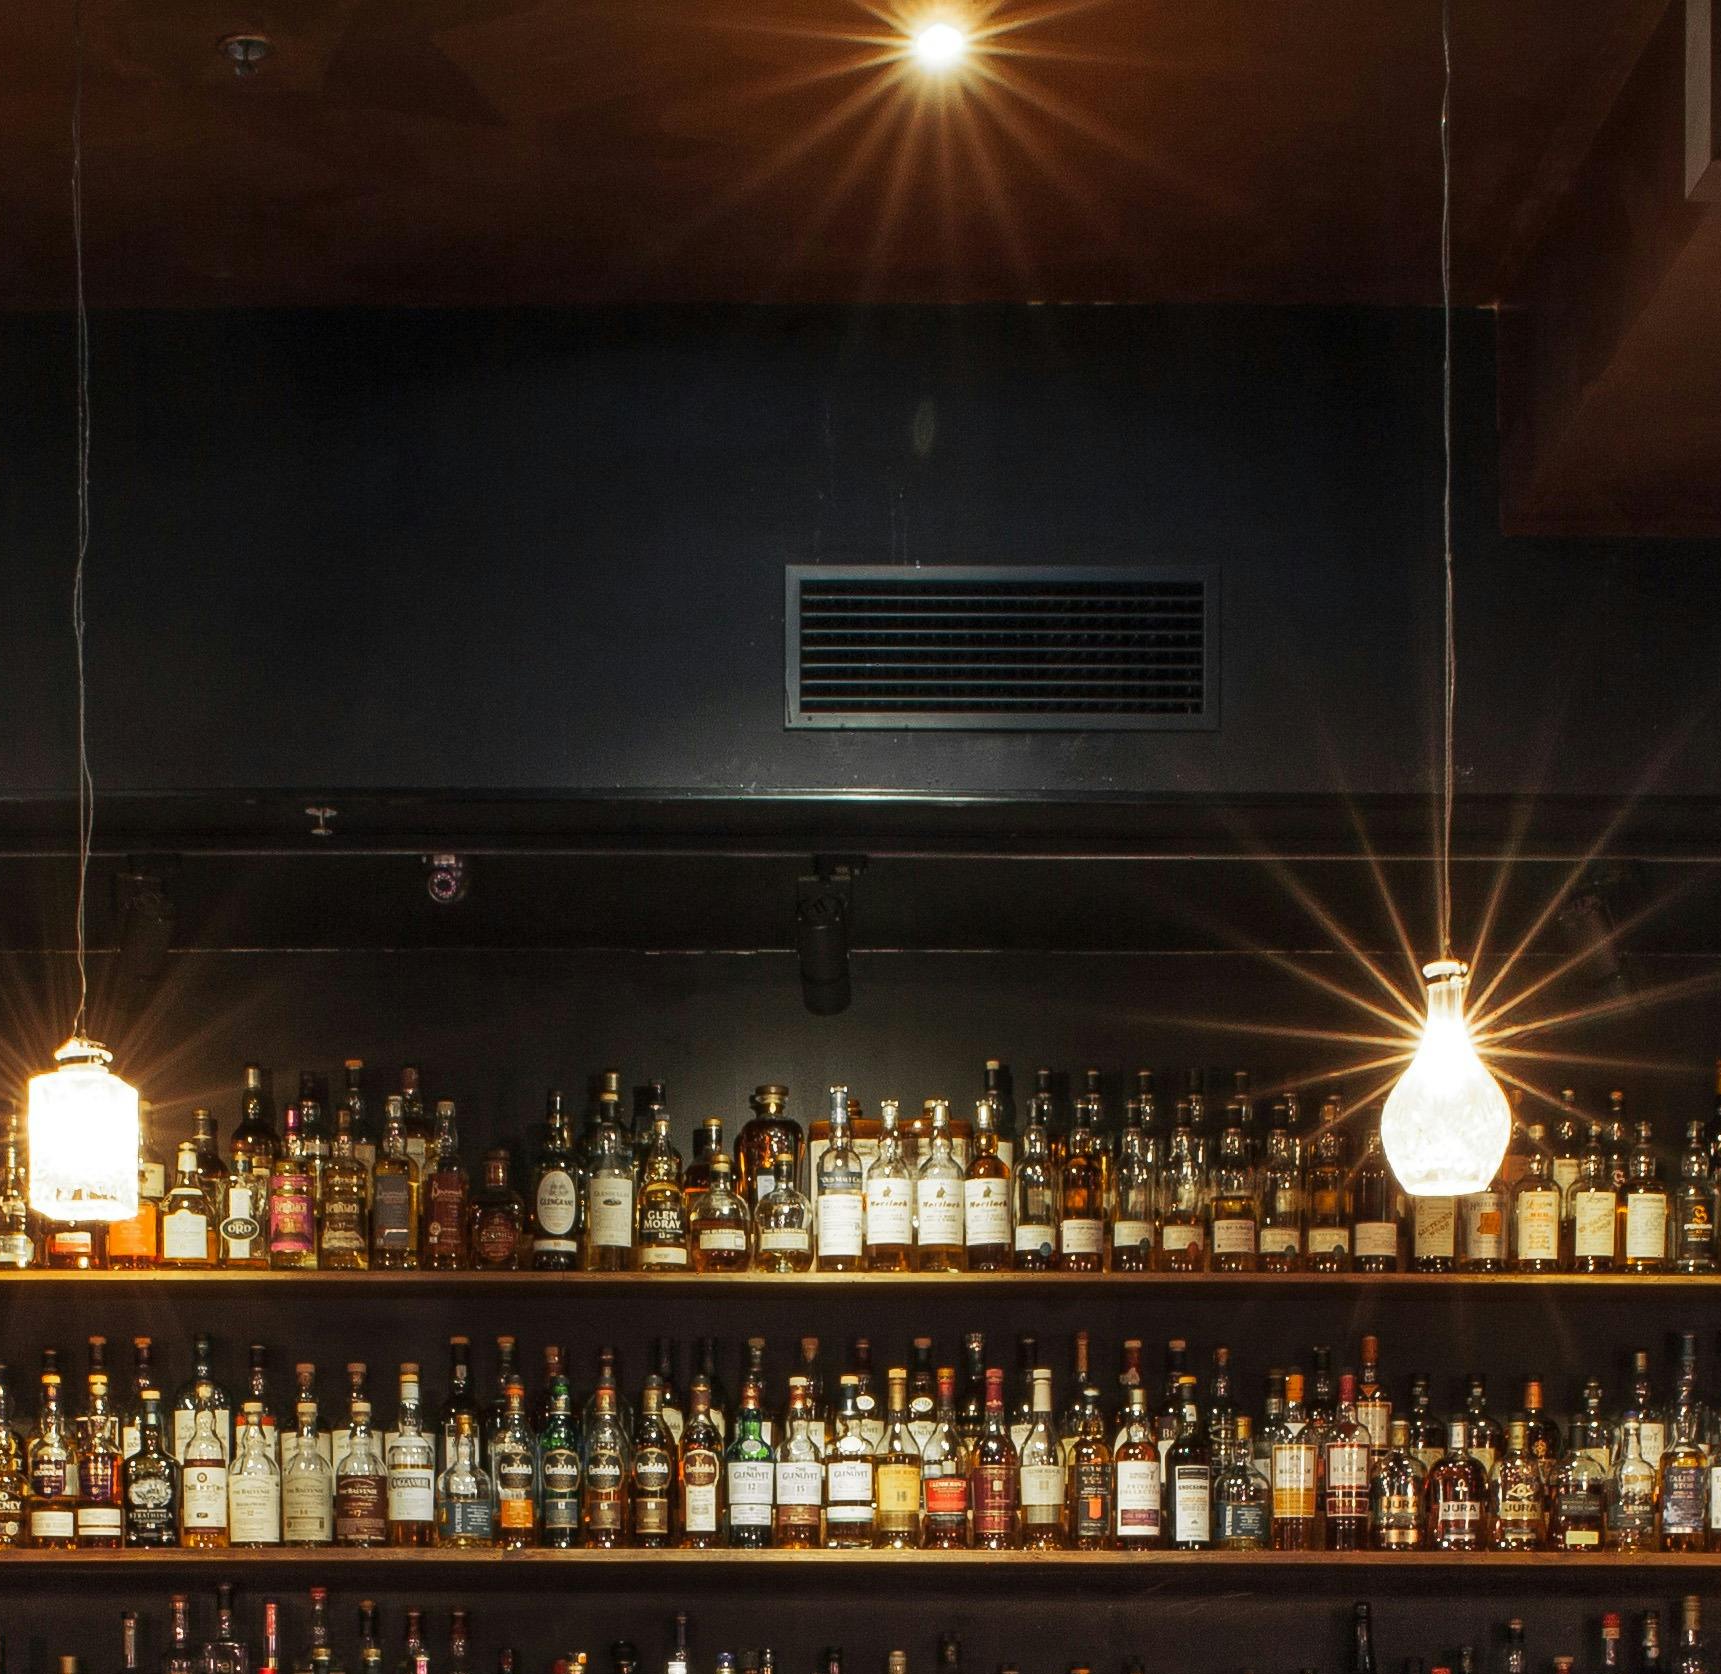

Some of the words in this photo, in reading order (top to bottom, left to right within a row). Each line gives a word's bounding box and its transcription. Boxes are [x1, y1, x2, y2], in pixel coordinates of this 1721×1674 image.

[647, 1210, 678, 1221] GLEN
[643, 1220, 682, 1230] MORAY
[733, 1471, 770, 1480] GLENLIVET
[782, 1472, 818, 1480] GLENLIVET
[833, 1470, 868, 1478] GLENLIVET
[747, 1483, 756, 1491] 12
[1384, 1499, 1419, 1510] JURA
[1443, 1504, 1477, 1513] JURA
[1504, 1503, 1538, 1513] JURA
